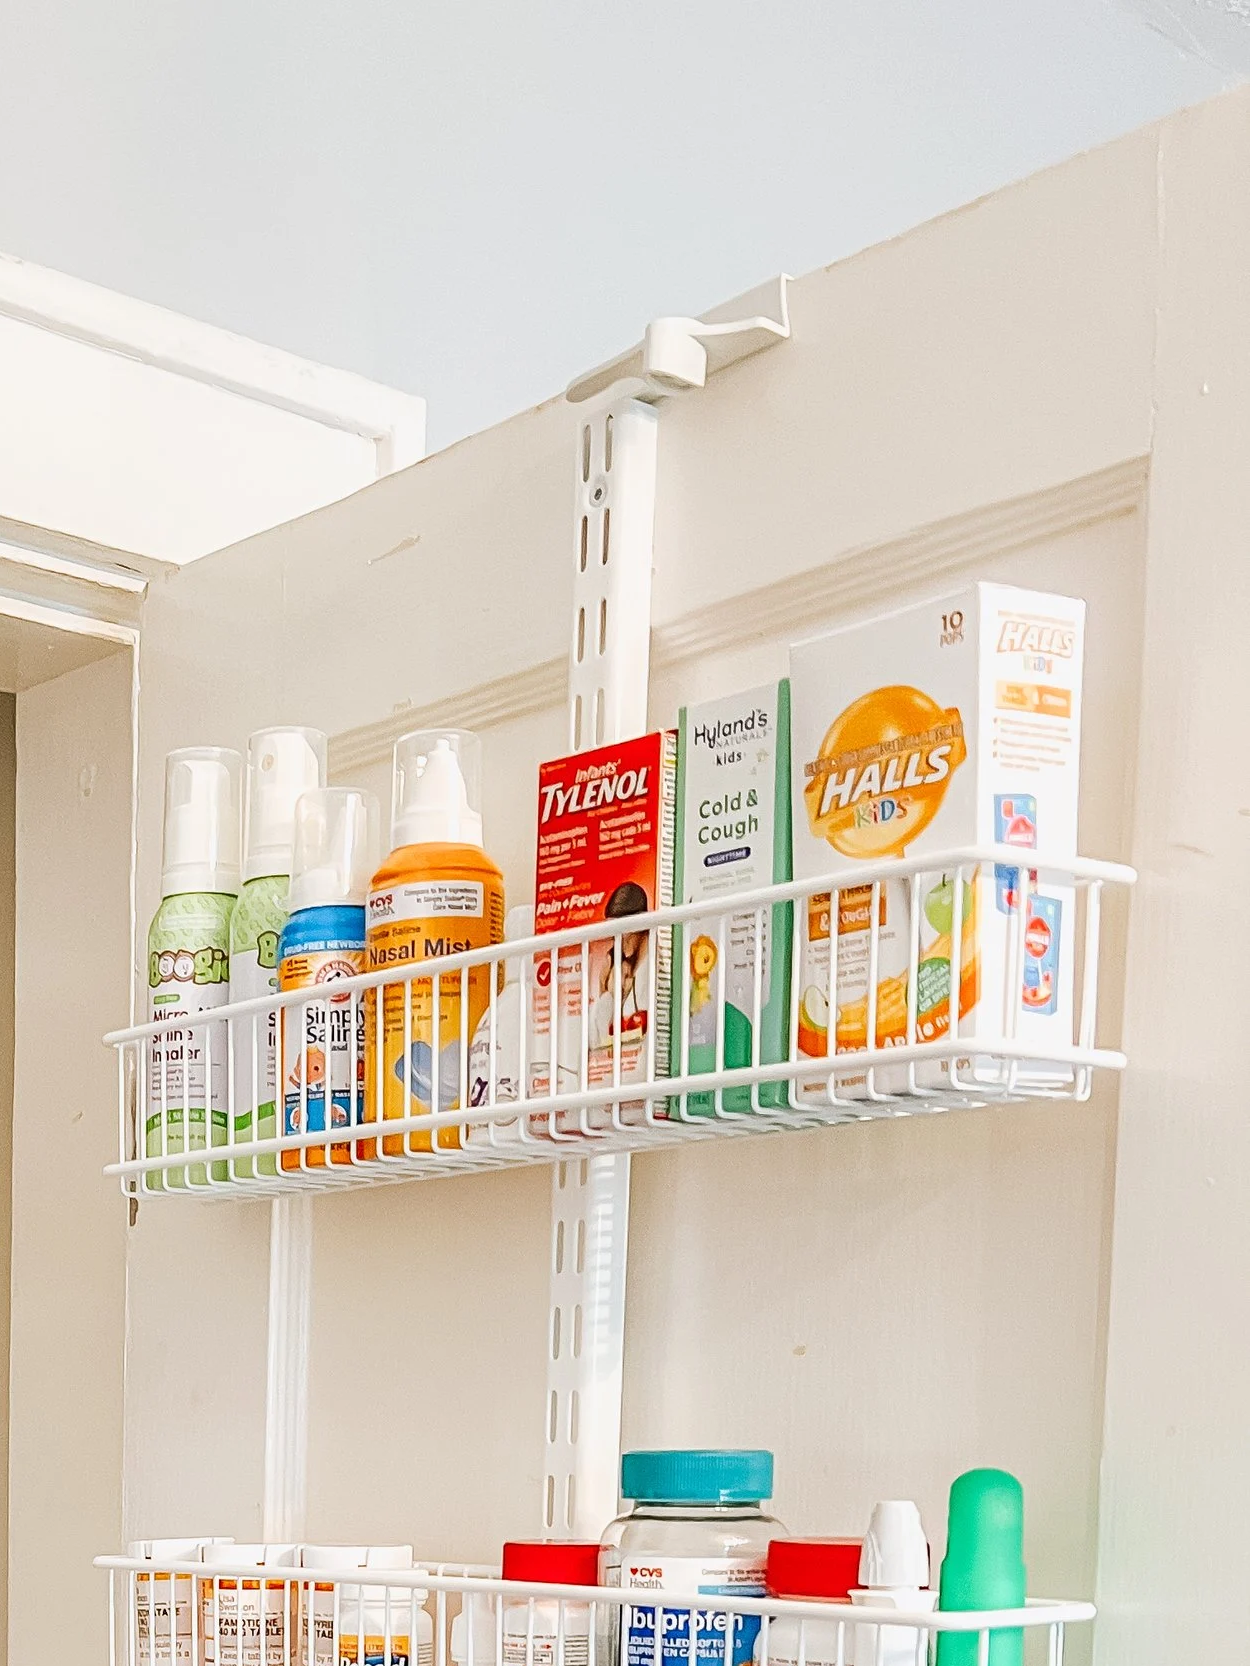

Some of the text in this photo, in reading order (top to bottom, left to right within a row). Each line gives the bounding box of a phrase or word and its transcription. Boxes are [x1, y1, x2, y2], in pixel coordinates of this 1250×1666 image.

[942, 611, 963, 632] 10
[997, 620, 1075, 658] HALLS
[694, 710, 768, 748] Hyland's
[716, 730, 770, 749] NATURALS
[716, 752, 742, 766] kids
[820, 746, 951, 816] HALLS
[541, 767, 649, 824] TYLENOL
[700, 789, 758, 818] Cold &
[699, 814, 758, 844] Cough
[537, 902, 562, 917] Pain
[570, 891, 605, 909] Fever
[370, 937, 472, 967] Nasal Mist
[306, 1007, 365, 1029] Simply
[307, 1026, 365, 1044] Saline
[640, 1567, 662, 1577] CVS
